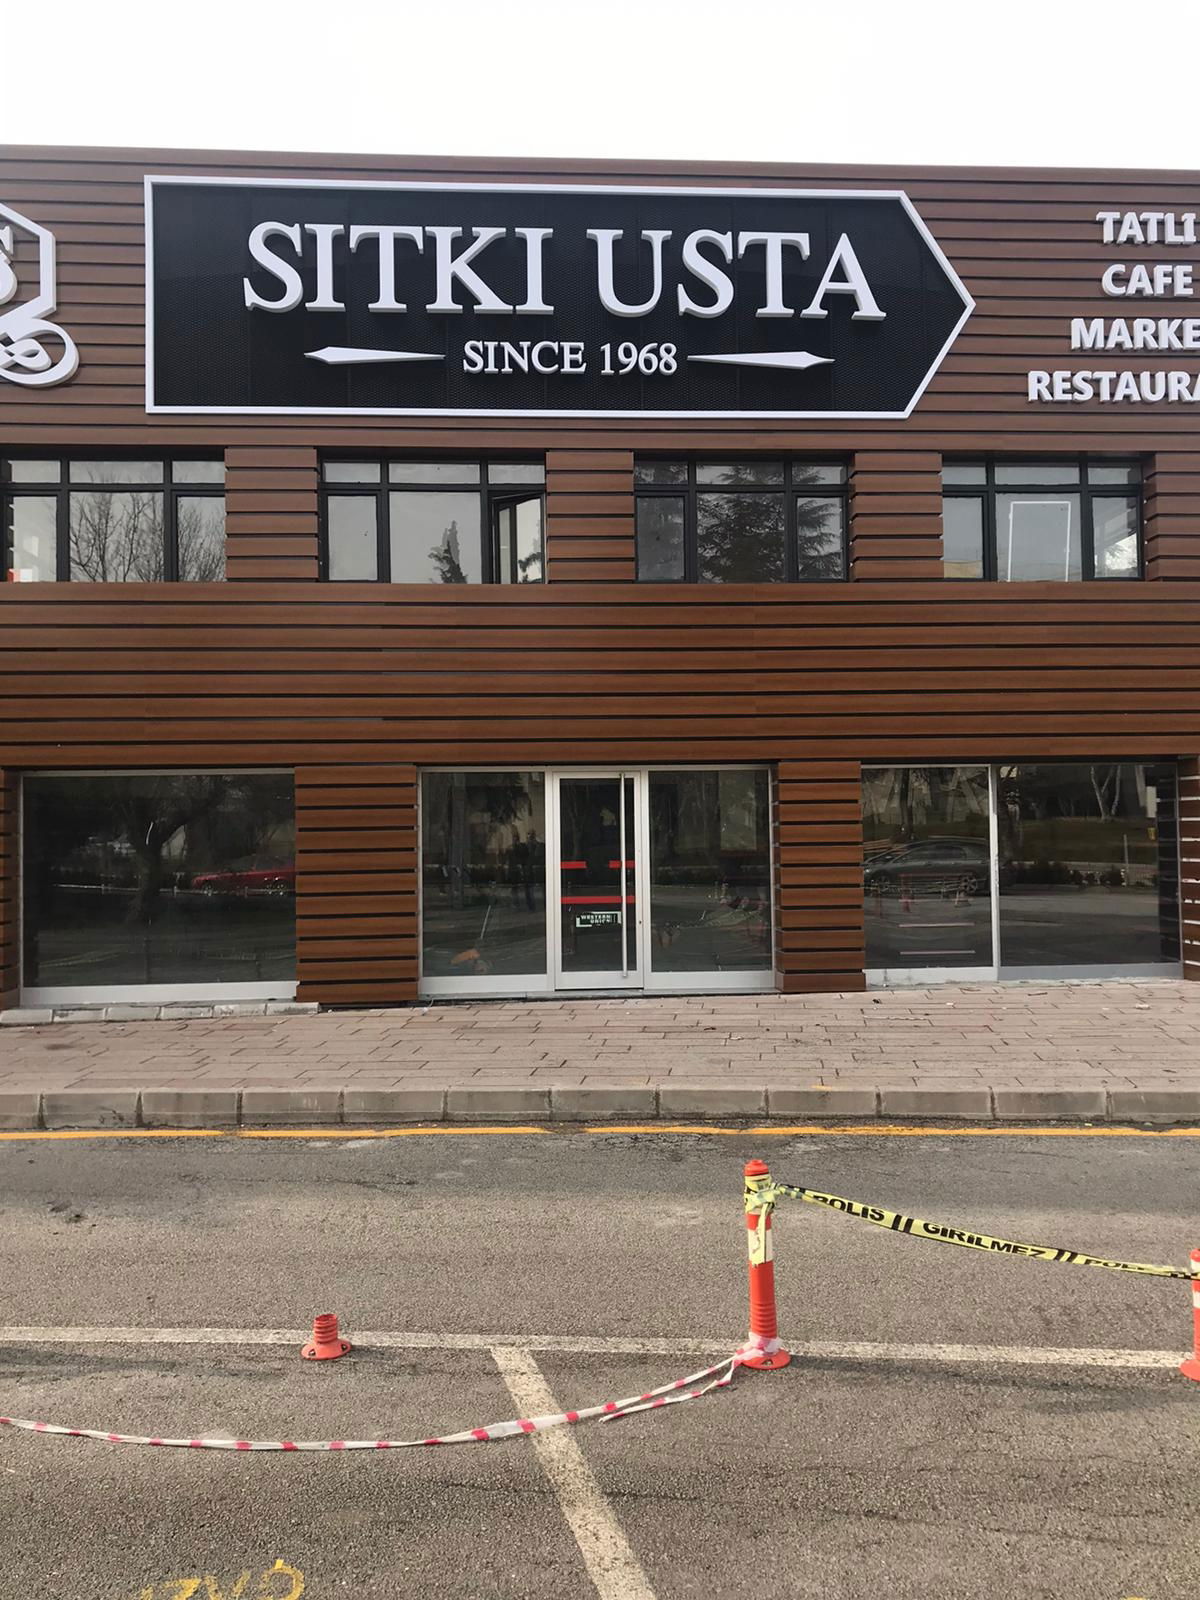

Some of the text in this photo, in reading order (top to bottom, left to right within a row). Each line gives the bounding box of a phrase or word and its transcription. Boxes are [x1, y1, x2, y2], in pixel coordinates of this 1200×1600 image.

[1096, 212, 1197, 244] TATLI
[243, 221, 887, 321] SITKI USTA
[1102, 264, 1194, 296] CAFE
[463, 340, 678, 375] SINCE 1968
[1028, 371, 1200, 402] RESTAUR
